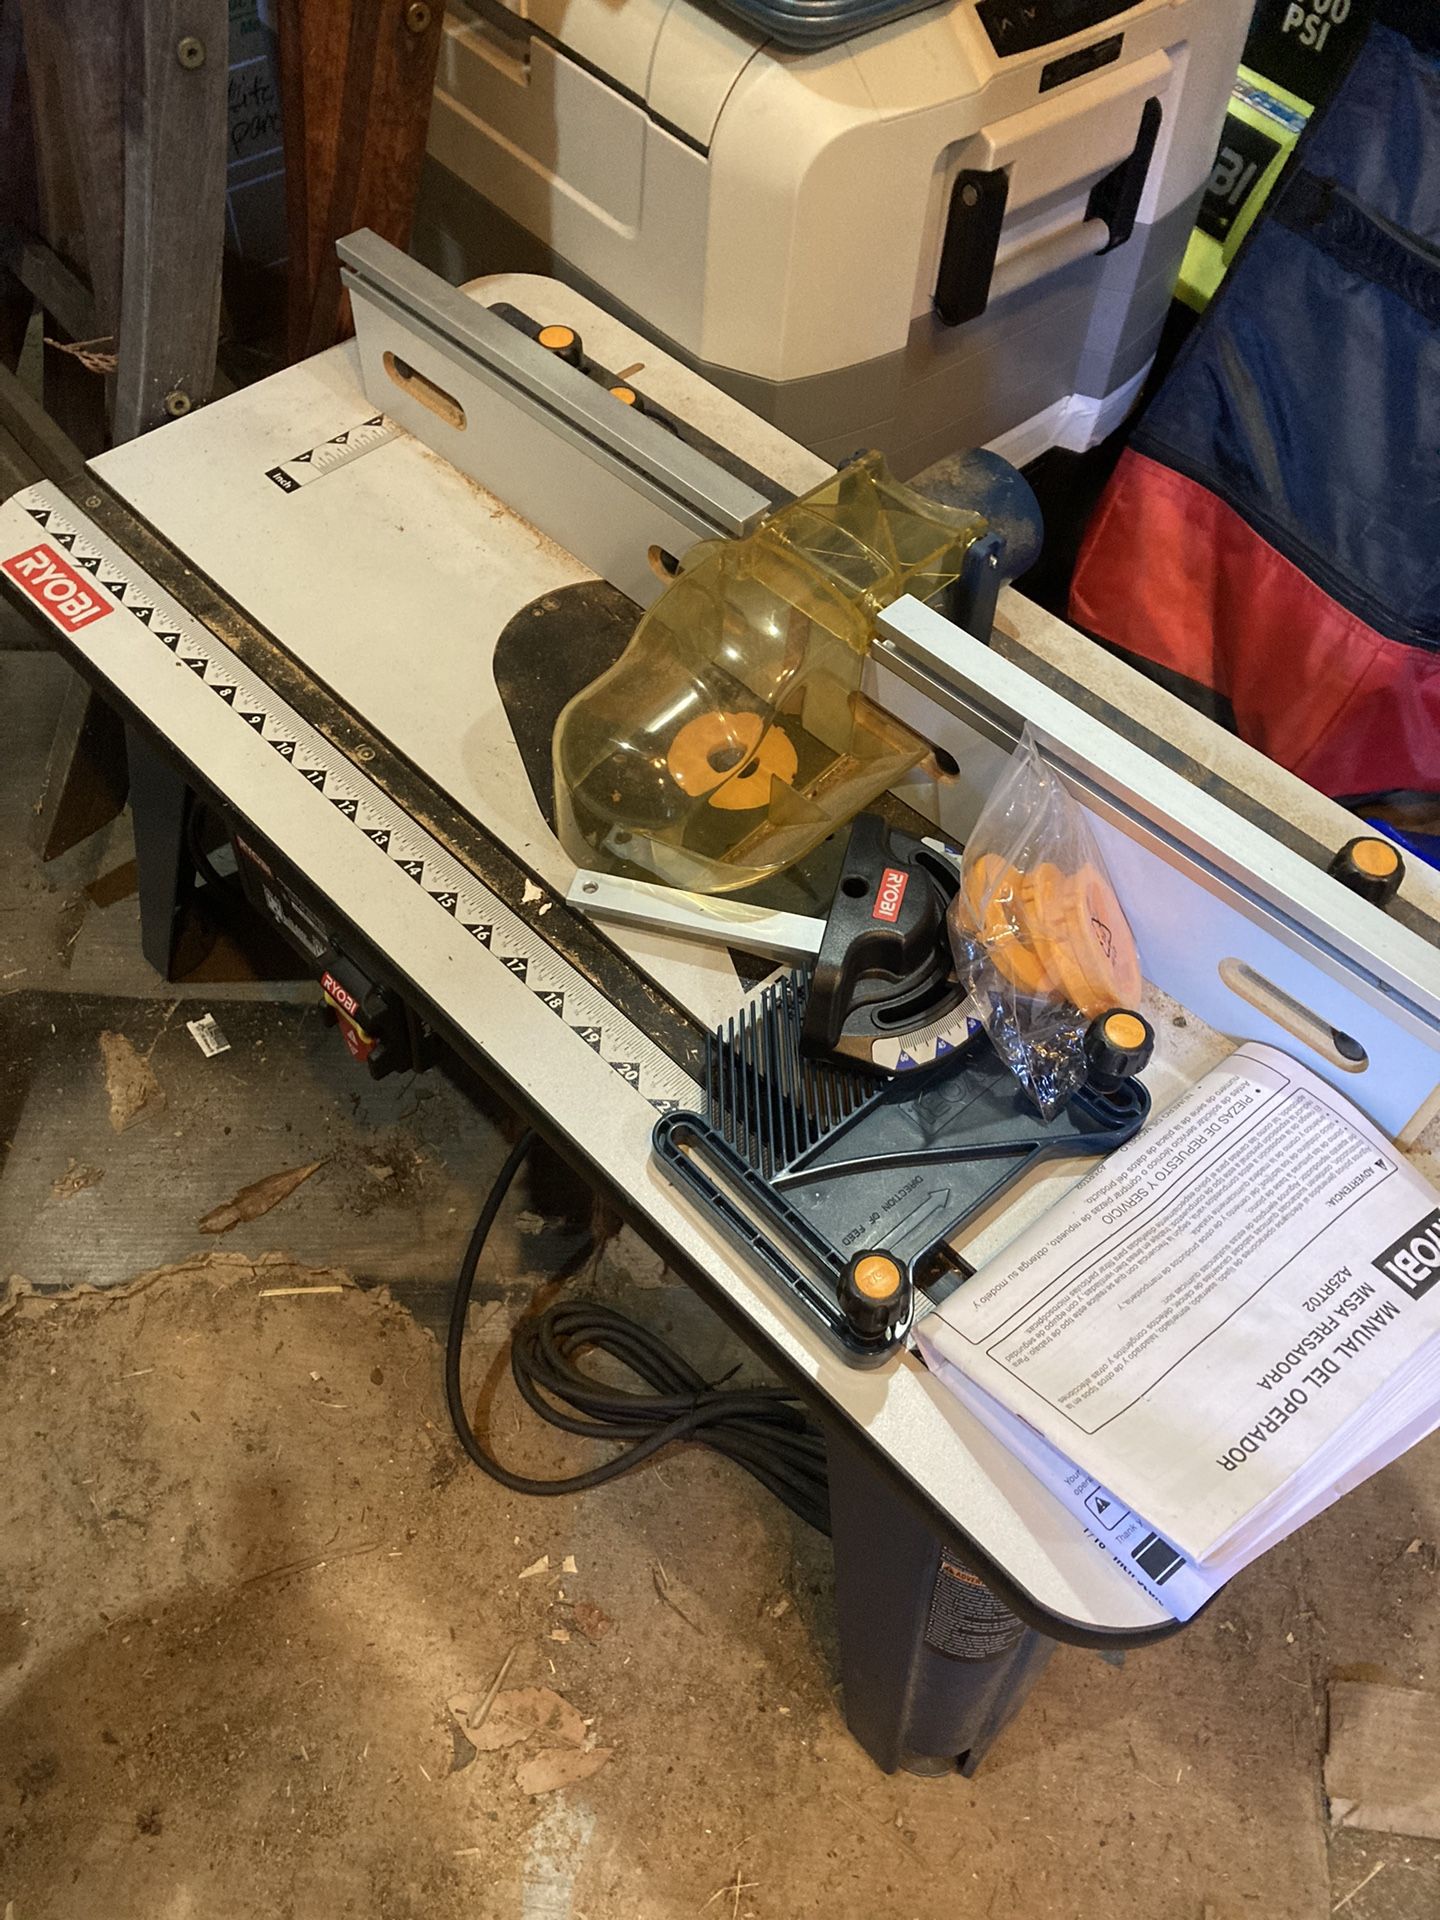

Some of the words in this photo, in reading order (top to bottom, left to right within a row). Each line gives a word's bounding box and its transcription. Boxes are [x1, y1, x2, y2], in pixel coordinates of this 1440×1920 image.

[1282, 3, 1331, 51] PSI
[272, 473, 293, 489] Inch
[15, 551, 101, 624] RYOBI
[136, 610, 148, 618] 5
[220, 689, 232, 697] 8
[249, 716, 261, 725] 9
[277, 742, 292, 755] 10
[307, 771, 323, 784] 11
[338, 801, 355, 814] 12
[371, 831, 388, 844] 13
[404, 861, 422, 875] 14
[437, 893, 455, 908] 15
[472, 926, 489, 940] 16
[506, 958, 526, 971] 17
[544, 993, 562, 1008] 18
[580, 1028, 599, 1043] 19
[617, 1064, 637, 1080] 20
[879, 872, 905, 917] RYOBI
[324, 973, 359, 1015] RYOBI
[1217, 1093, 1254, 1126] PIEZAS
[1154, 1128, 1175, 1148] placa
[1203, 1121, 1221, 1137] DE
[1146, 1145, 1158, 1156] de
[1147, 1146, 1173, 1171] técnico
[1153, 1133, 1207, 1182] REPUESTO
[1115, 1171, 1128, 1183] del
[1126, 1154, 1148, 1174] datos
[1140, 1168, 1147, 1176] o
[881, 1174, 924, 1212] DIRECTION
[1111, 1172, 1141, 1199] comprar
[1145, 1177, 1157, 1189] Y
[1324, 1165, 1374, 1209] ADVERTENCIA:
[868, 1211, 882, 1225] OF
[1080, 1212, 1092, 1223] de
[1088, 1195, 1114, 1216] piezas
[1100, 1185, 1148, 1226] SERVICIO
[841, 1224, 866, 1247] FEED
[1045, 1218, 1081, 1249] repuesto,
[1015, 1244, 1049, 1273] obtenga
[1007, 1270, 1018, 1280] su
[979, 1278, 1009, 1305] modelo
[1302, 1265, 1352, 1313] A25RT02
[1333, 1281, 1375, 1321] MESA
[1034, 1328, 1045, 1339] de
[1050, 1327, 1061, 1338] de
[1332, 1299, 1400, 1364] MANUAL
[1256, 1315, 1339, 1393] FRESADORA
[1096, 1371, 1115, 1387] otros
[1113, 1362, 1124, 1373] de
[1301, 1356, 1340, 1393] DEL
[1215, 1386, 1308, 1474] OPERADOR
[1064, 1470, 1082, 1486] Your
[1115, 1524, 1138, 1545] Thank
